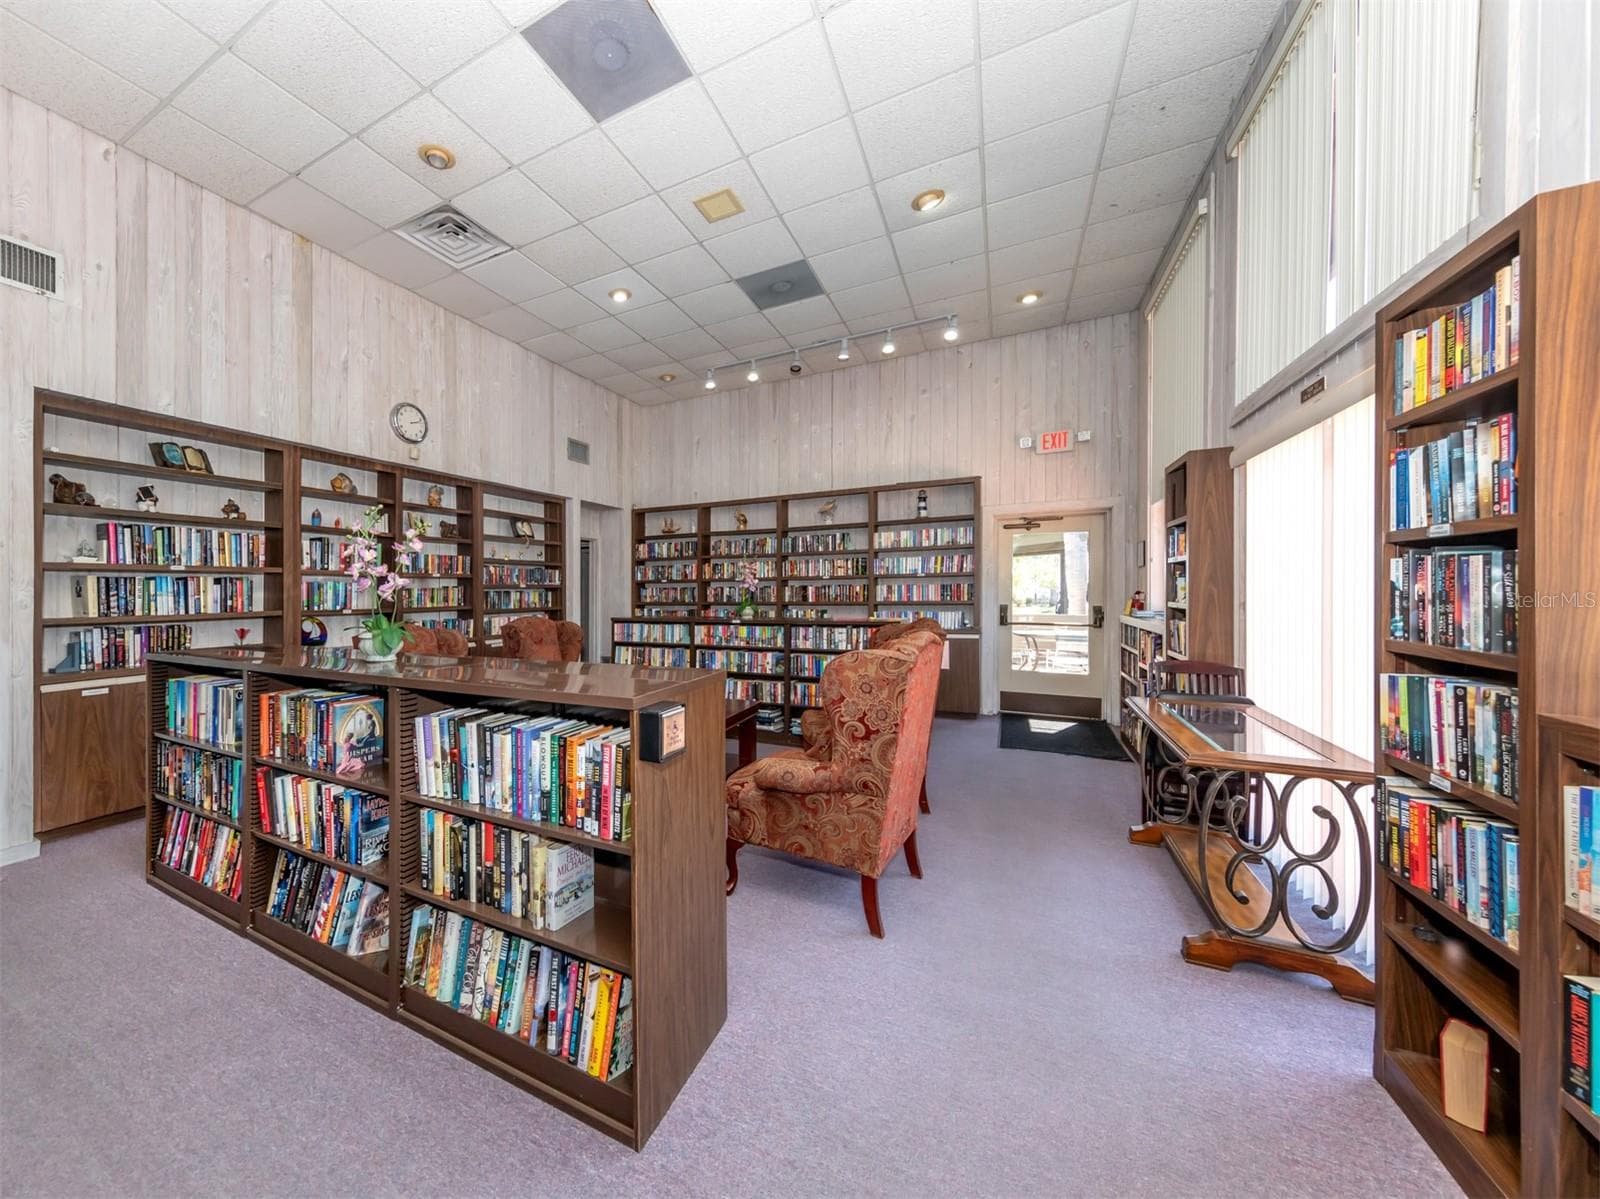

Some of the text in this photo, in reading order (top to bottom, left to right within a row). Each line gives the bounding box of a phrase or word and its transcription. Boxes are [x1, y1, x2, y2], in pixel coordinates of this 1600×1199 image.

[1446, 319, 1455, 367] DAVID BALDACCI
[1042, 431, 1068, 450] EXIT
[1431, 443, 1441, 490] SANDRA BROWN
[569, 740, 577, 758] PHILLIP
[1502, 751, 1511, 764] LISA
[1503, 765, 1512, 796] JACKSON
[1469, 829, 1479, 879] SUSAN MALLERY
[1570, 995, 1589, 1070] JAMES PATTERSON
